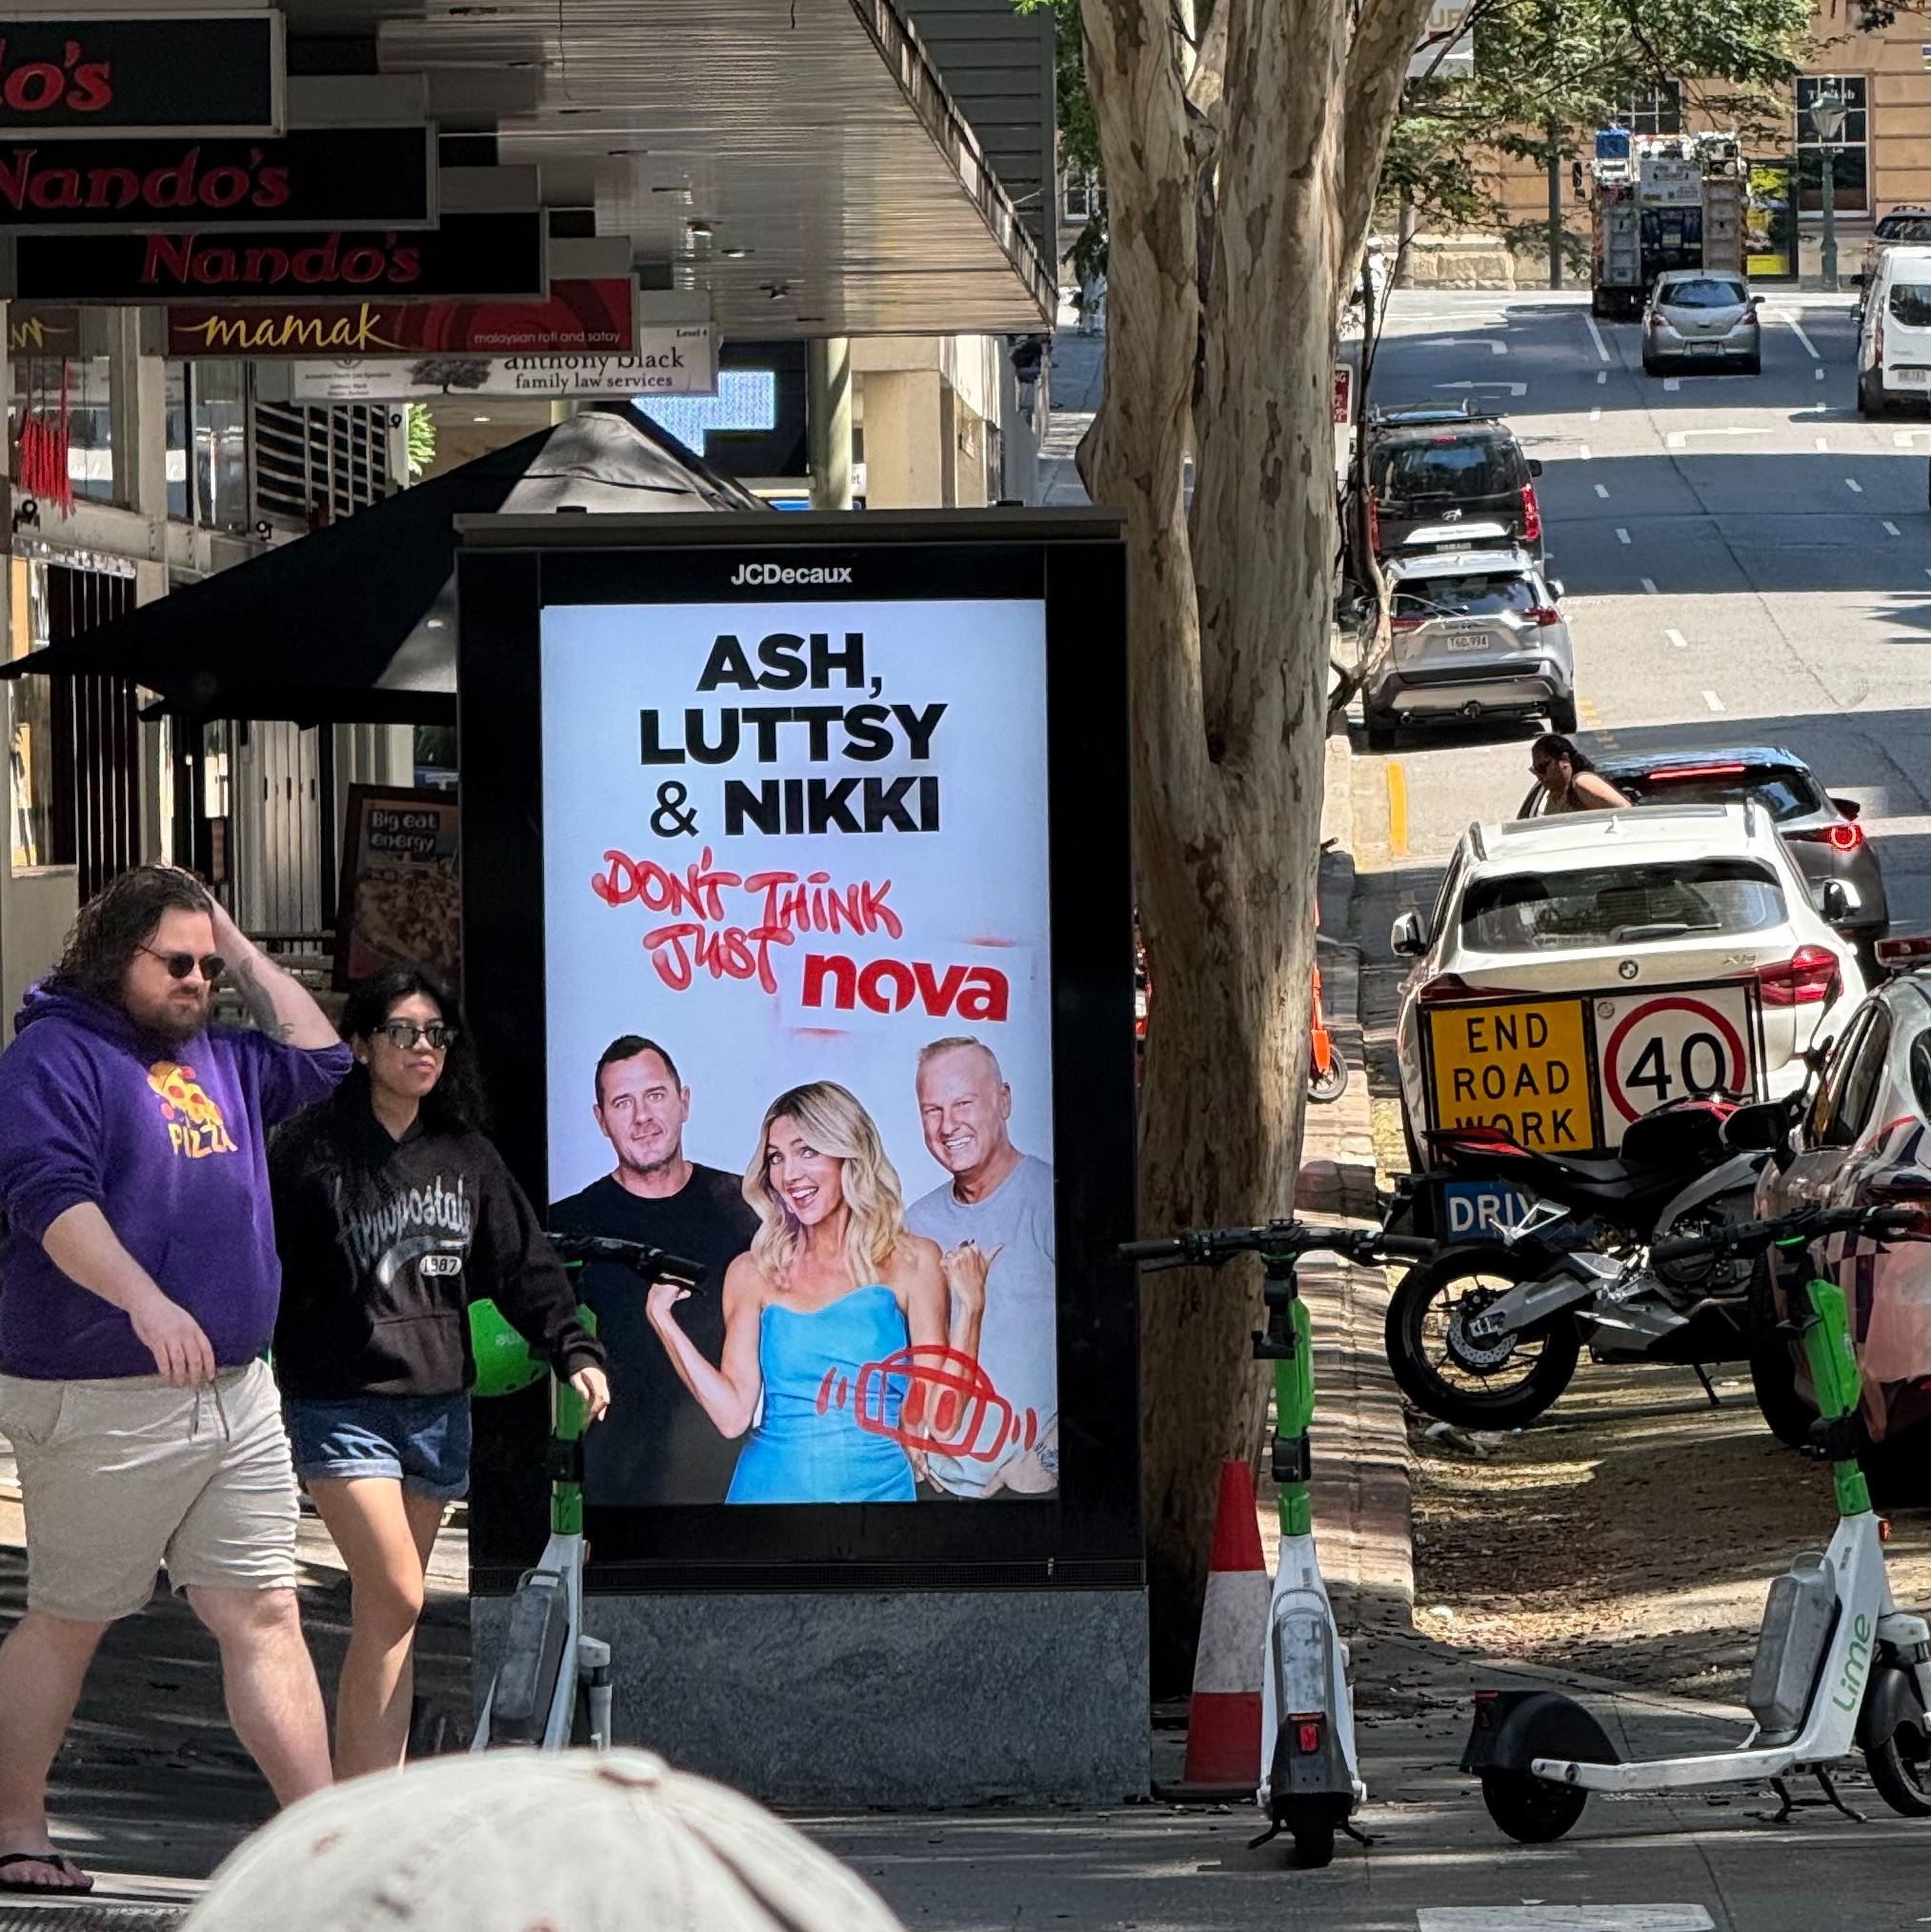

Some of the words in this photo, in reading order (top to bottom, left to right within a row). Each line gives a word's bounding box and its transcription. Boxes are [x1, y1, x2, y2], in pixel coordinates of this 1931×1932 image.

[0, 38, 112, 111] o's
[0, 145, 290, 211] Nando's
[141, 231, 421, 285] Nando's
[176, 302, 410, 351] mamak
[474, 332, 536, 345] malaysian
[538, 331, 557, 343] roti
[559, 331, 585, 343] and
[587, 331, 620, 345] satay
[676, 329, 700, 337] Level
[515, 372, 569, 393] family
[574, 372, 603, 388] law
[607, 373, 673, 388] services
[731, 563, 853, 585] JCDecaux
[695, 632, 882, 698] ASH,
[640, 704, 948, 765] LUTTSY
[372, 811, 400, 833] Big
[402, 813, 437, 830] eat
[650, 780, 699, 837] &
[724, 775, 939, 835] NIKKI
[371, 833, 435, 853] energy
[591, 846, 742, 920] DON'T
[642, 921, 795, 994] JUST
[800, 953, 1010, 1022] nova
[1467, 1012, 1548, 1053] END
[1454, 1060, 1570, 1102] ROAD
[1625, 1032, 1726, 1100] 40
[424, 1258, 458, 1273] 1987
